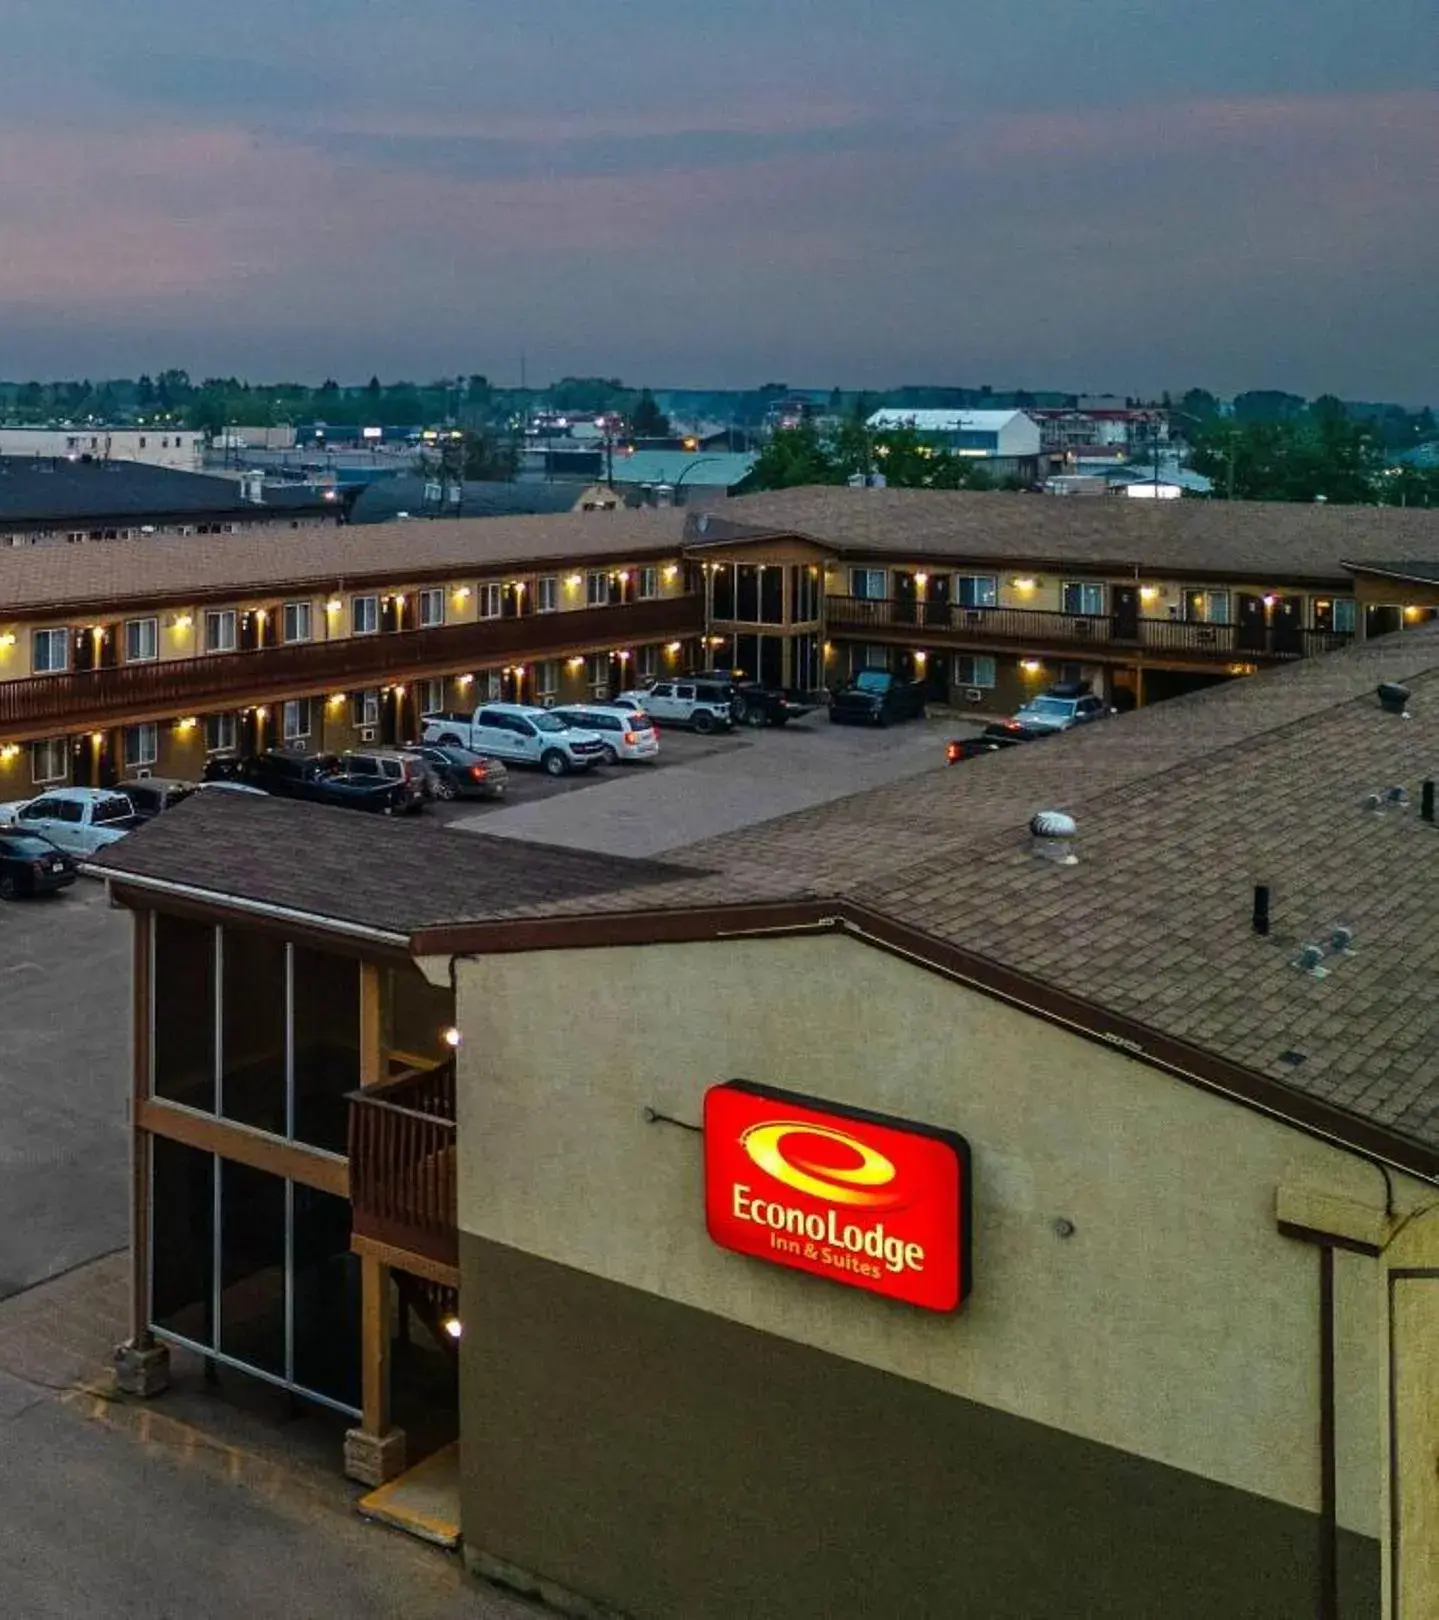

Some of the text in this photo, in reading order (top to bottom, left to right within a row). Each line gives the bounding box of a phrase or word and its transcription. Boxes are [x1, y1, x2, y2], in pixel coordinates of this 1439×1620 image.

[732, 1183, 925, 1273] EconoLodge
[769, 1232, 882, 1279] Inn & Suites
